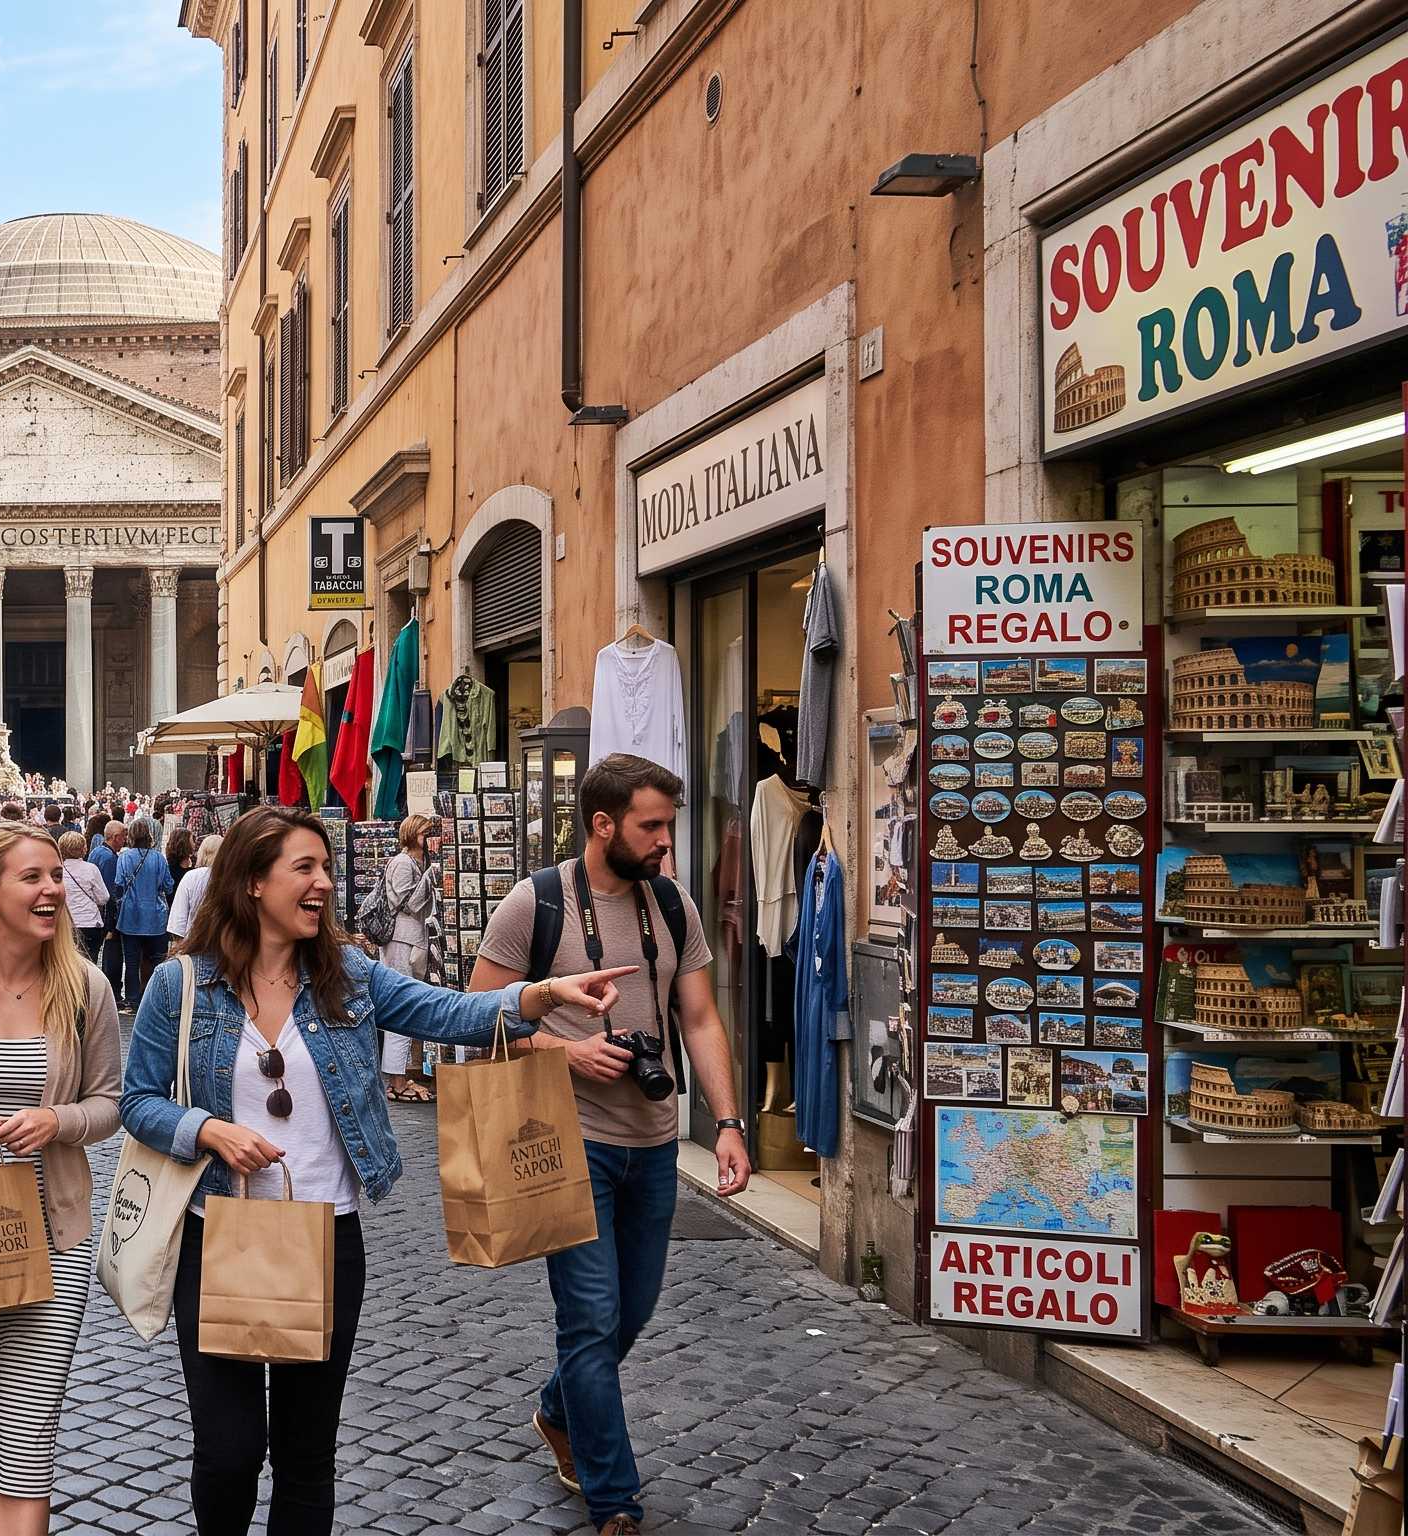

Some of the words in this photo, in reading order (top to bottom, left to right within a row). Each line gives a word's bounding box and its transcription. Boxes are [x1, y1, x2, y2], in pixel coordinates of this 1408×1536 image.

[1138, 233, 1362, 402] ROMA
[641, 473, 700, 548] MODA
[704, 412, 824, 522] ITALIANA
[931, 531, 1135, 568] SOUVENIRS
[314, 580, 363, 591] TABACCHI
[975, 572, 1094, 605] ROMA
[948, 611, 1113, 645] REGALO
[510, 1136, 561, 1165] ANTICHI
[514, 1153, 563, 1181] SAPORI
[939, 1240, 1132, 1287] ARTICOLI
[953, 1281, 1119, 1326] REGALO
